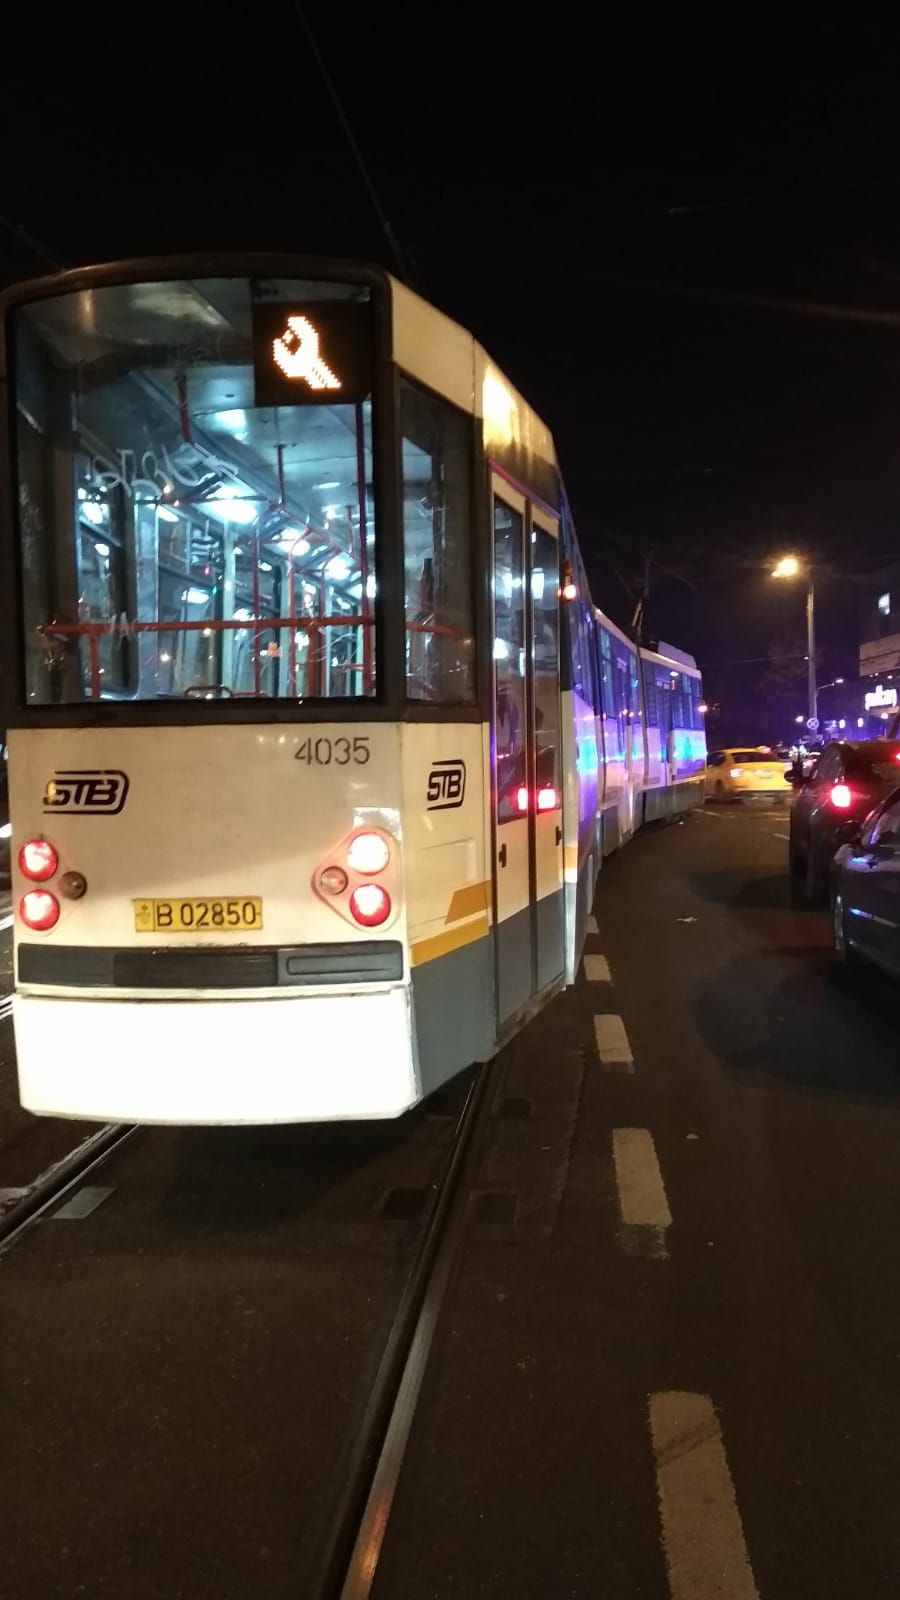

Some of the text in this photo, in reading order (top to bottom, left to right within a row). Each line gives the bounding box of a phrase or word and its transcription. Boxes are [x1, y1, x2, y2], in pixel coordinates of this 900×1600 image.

[294, 737, 371, 765] 4035
[43, 778, 120, 806] STB
[427, 769, 462, 801] STB
[156, 901, 256, 927] B 02850
